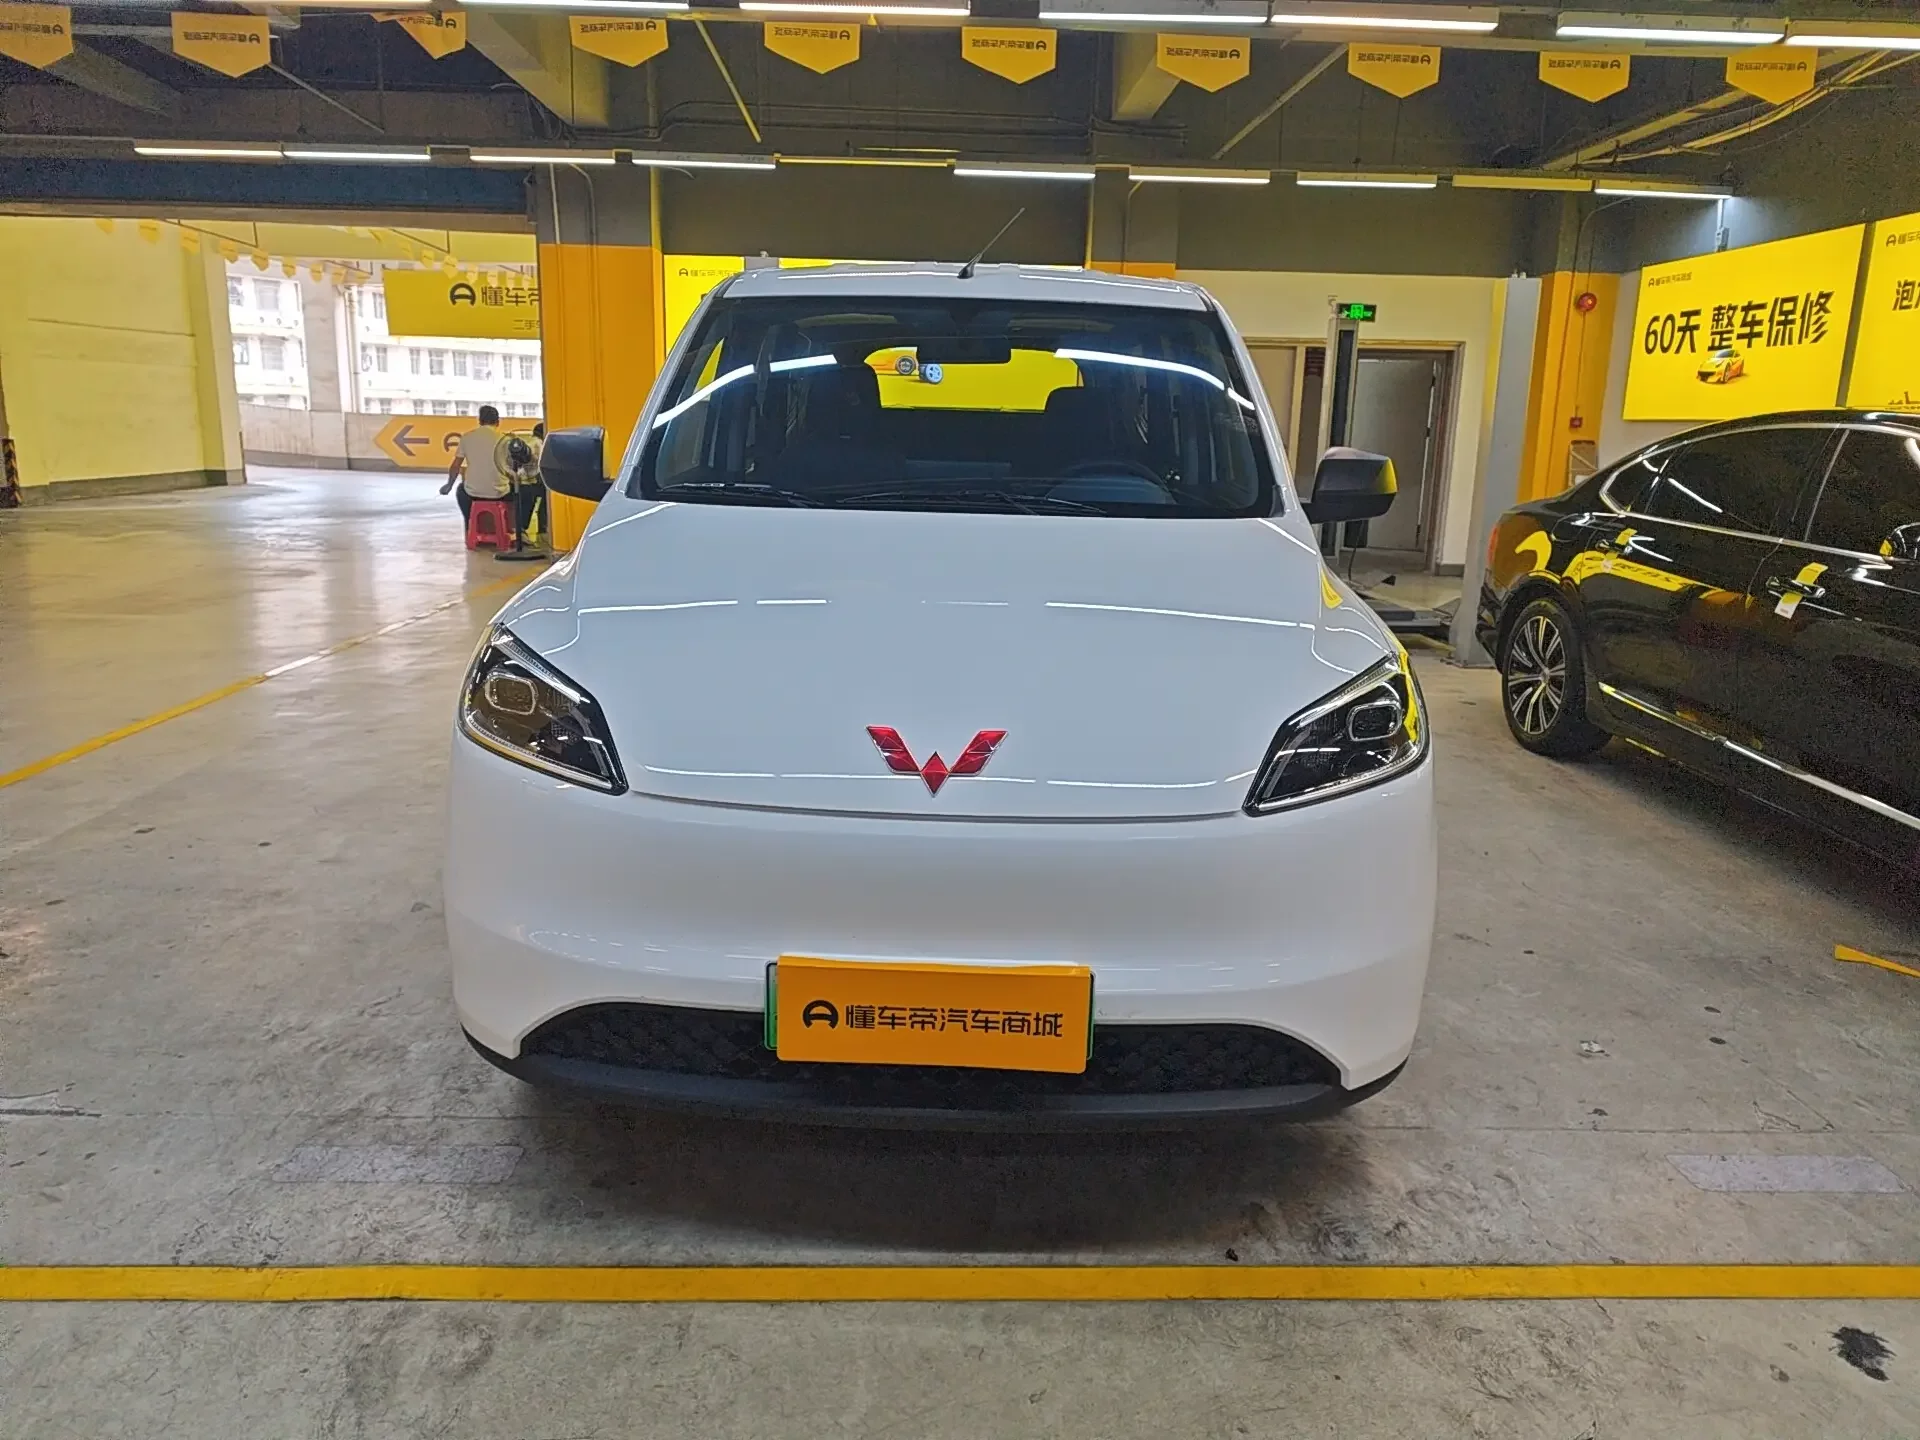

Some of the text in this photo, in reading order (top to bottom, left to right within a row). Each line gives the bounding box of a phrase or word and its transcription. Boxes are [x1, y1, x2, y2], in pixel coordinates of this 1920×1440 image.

[1644, 290, 1835, 355] 60天 整车保修
[845, 1004, 1064, 1038] 懂车帝汽车商城
